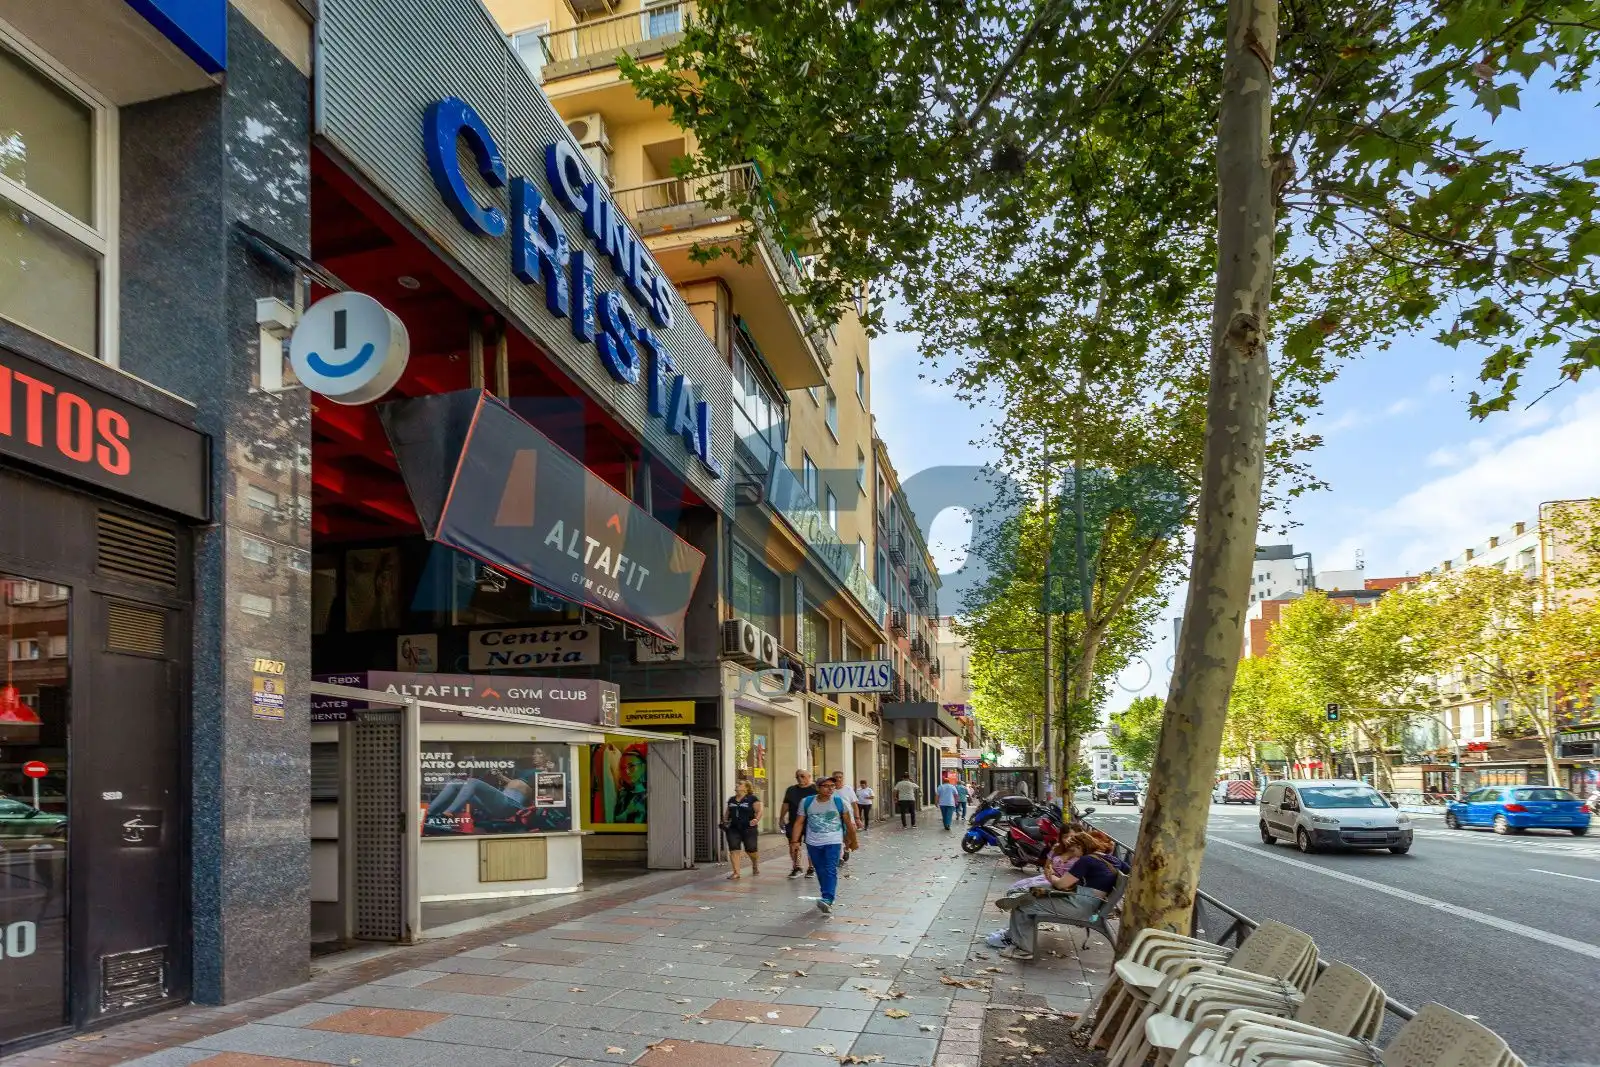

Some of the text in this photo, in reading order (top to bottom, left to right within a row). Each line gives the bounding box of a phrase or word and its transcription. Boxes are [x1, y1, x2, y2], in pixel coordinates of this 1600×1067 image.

[546, 140, 674, 329] CINES
[423, 96, 723, 479] CRISTAL
[543, 520, 650, 592] ALTAFIT
[571, 572, 620, 602] GYM CLUB
[479, 626, 588, 647] Centro
[257, 660, 284, 674] 120
[487, 647, 582, 667] Novia
[817, 663, 890, 689] NOVIAS
[385, 684, 587, 700] ALTAFIT GYM CLUB
[457, 760, 515, 769] CAMINOS
[429, 817, 471, 825] ALTAFIT
